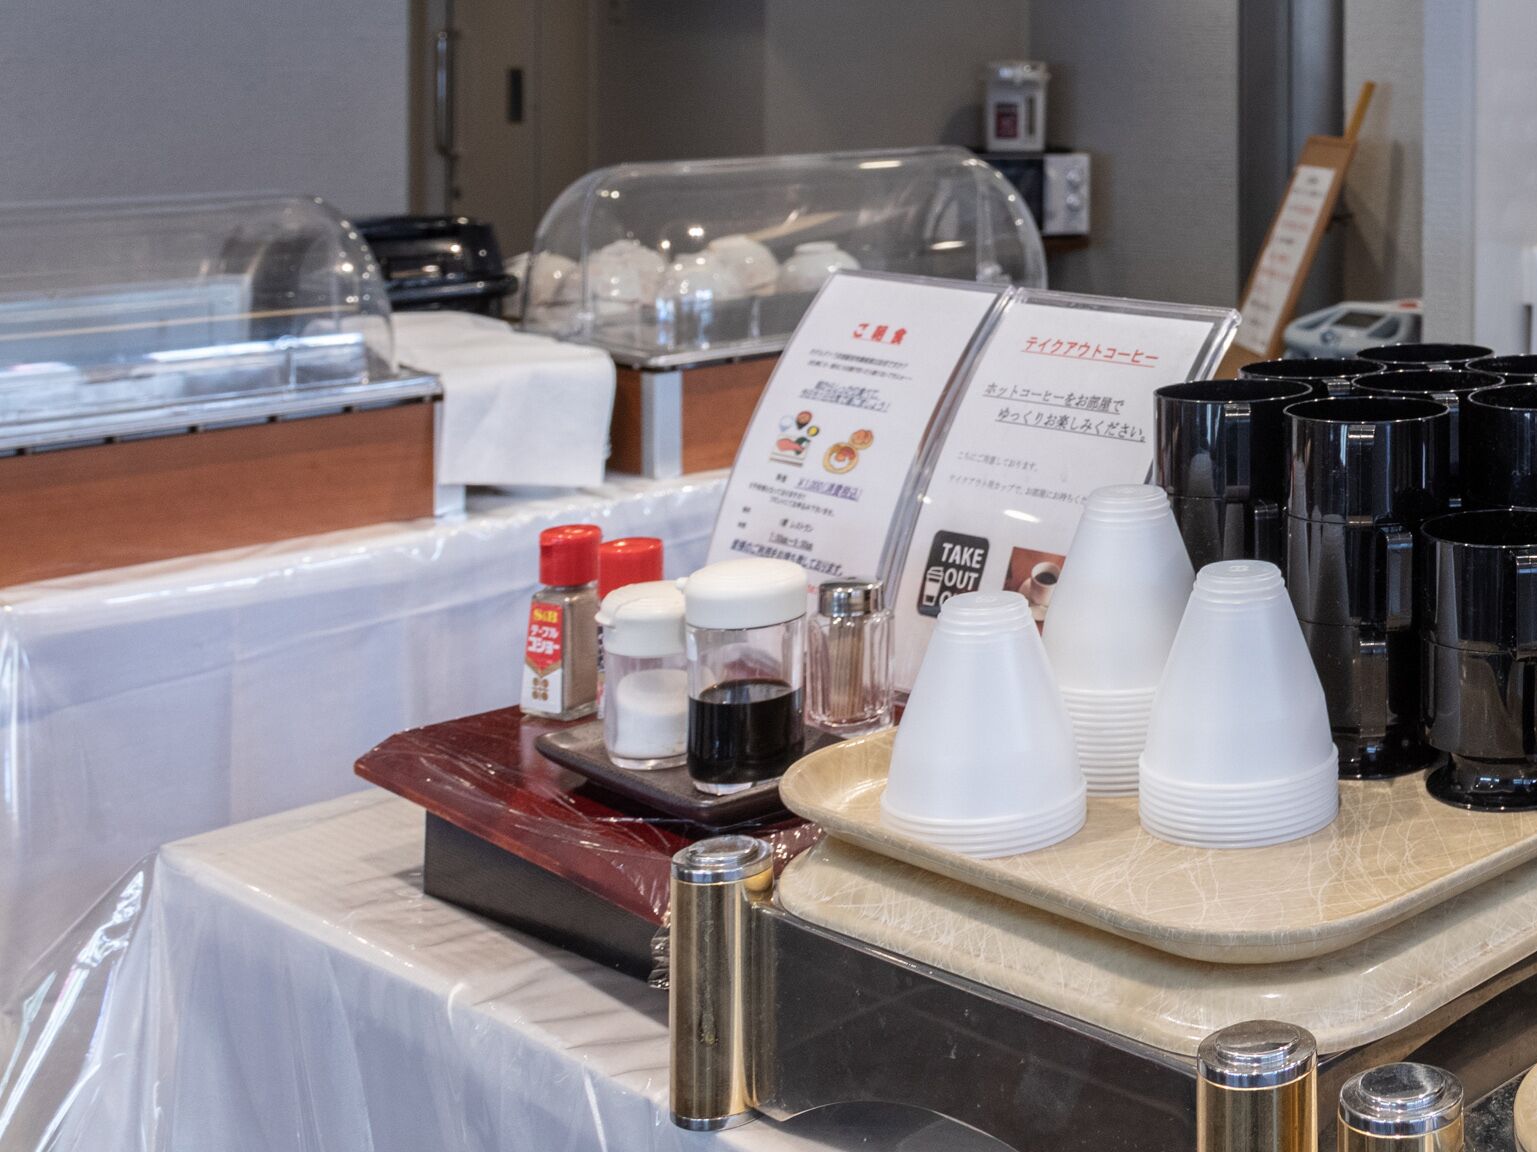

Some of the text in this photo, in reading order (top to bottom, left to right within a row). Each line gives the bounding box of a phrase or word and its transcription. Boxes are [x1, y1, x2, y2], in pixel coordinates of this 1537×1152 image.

[1025, 335, 1159, 365] テイクアウトコーヒー
[985, 382, 1126, 413] ホットコーヒーをお部屋で
[996, 407, 1147, 443] ゆっくりお楽しみください。
[941, 542, 985, 569] TAKE
[943, 567, 979, 591] OUT
